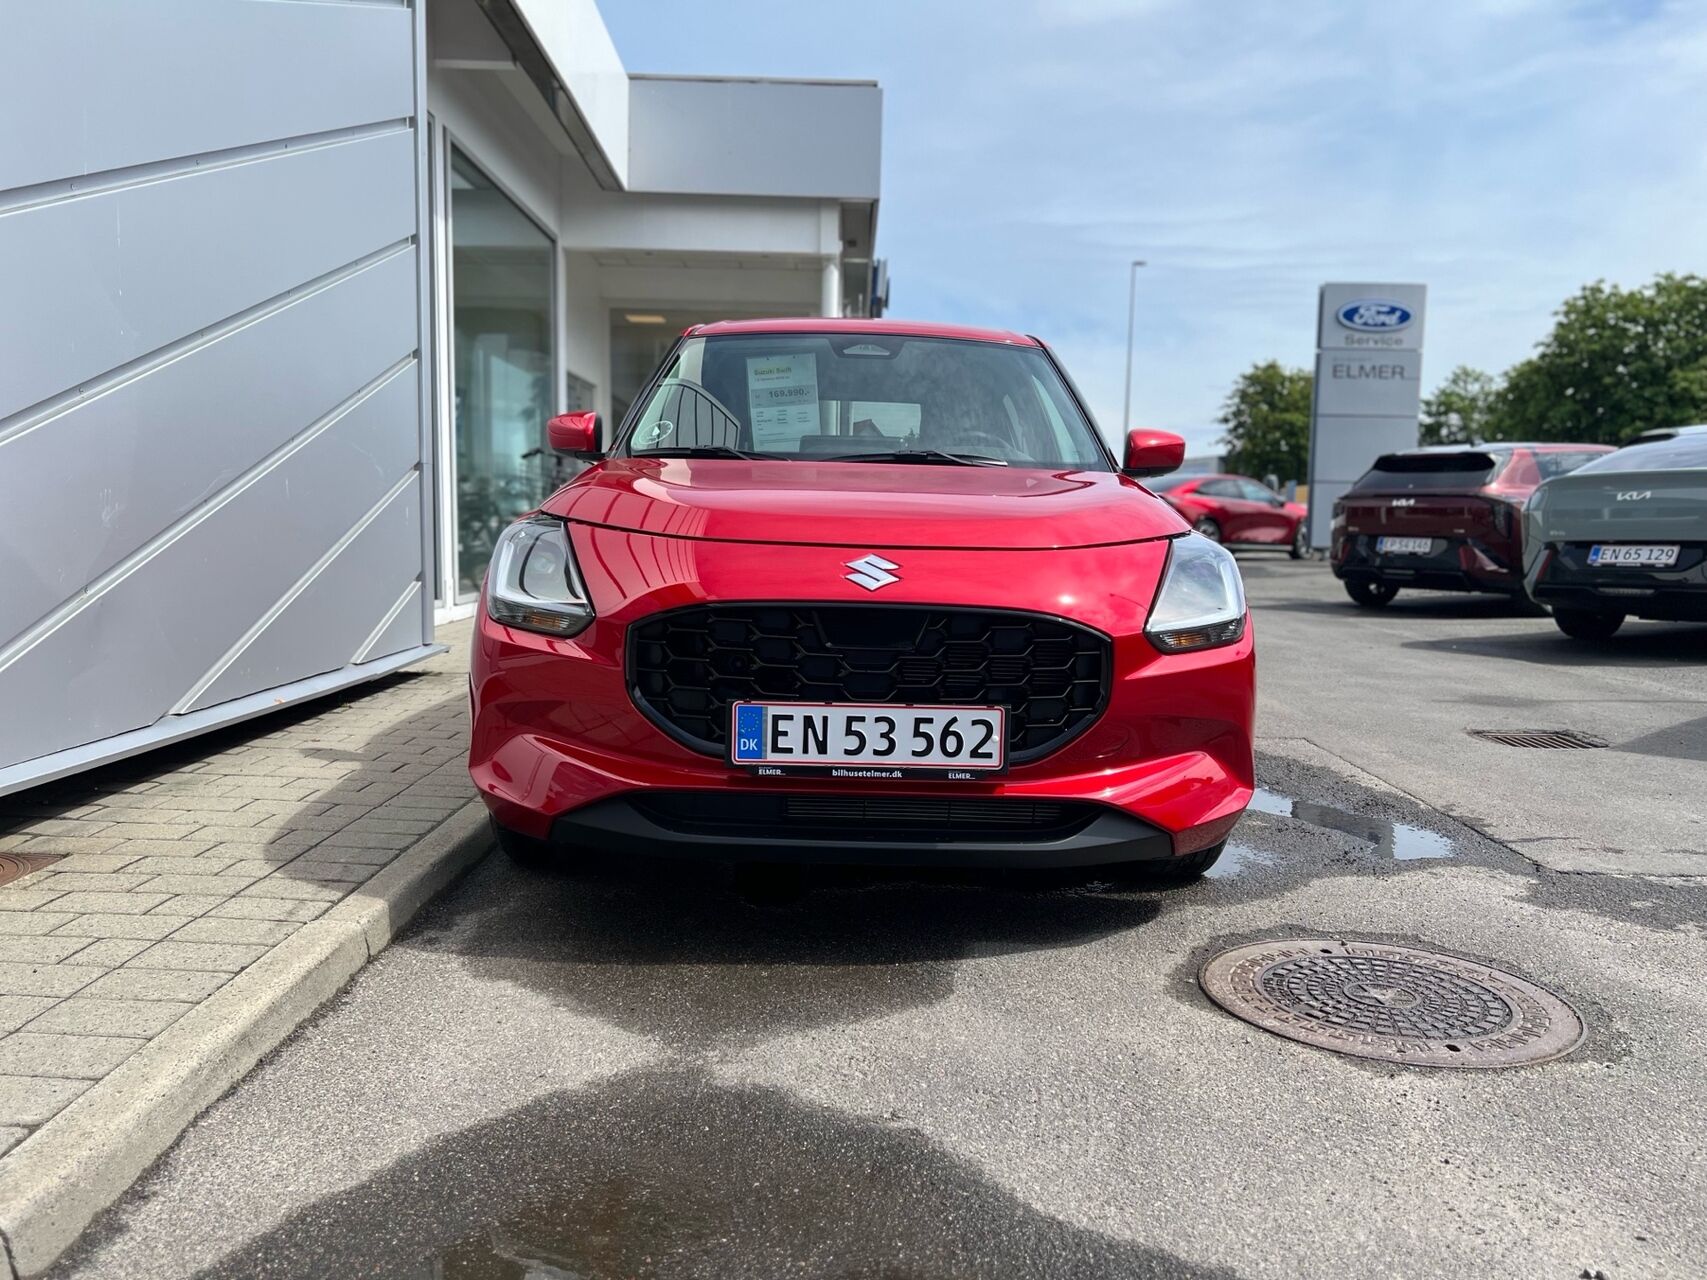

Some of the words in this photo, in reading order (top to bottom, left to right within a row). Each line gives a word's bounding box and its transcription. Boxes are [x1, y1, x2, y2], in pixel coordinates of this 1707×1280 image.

[1344, 334, 1404, 347] Service
[1332, 364, 1406, 380] ELMER
[1600, 547, 1621, 561] EN
[1623, 548, 1643, 561] 65
[1645, 548, 1676, 561] 129
[771, 714, 829, 755] EN
[843, 715, 897, 757] 53
[911, 716, 995, 760] 562
[740, 738, 758, 751] DK
[831, 769, 903, 779] bilhusetelmer.dk
